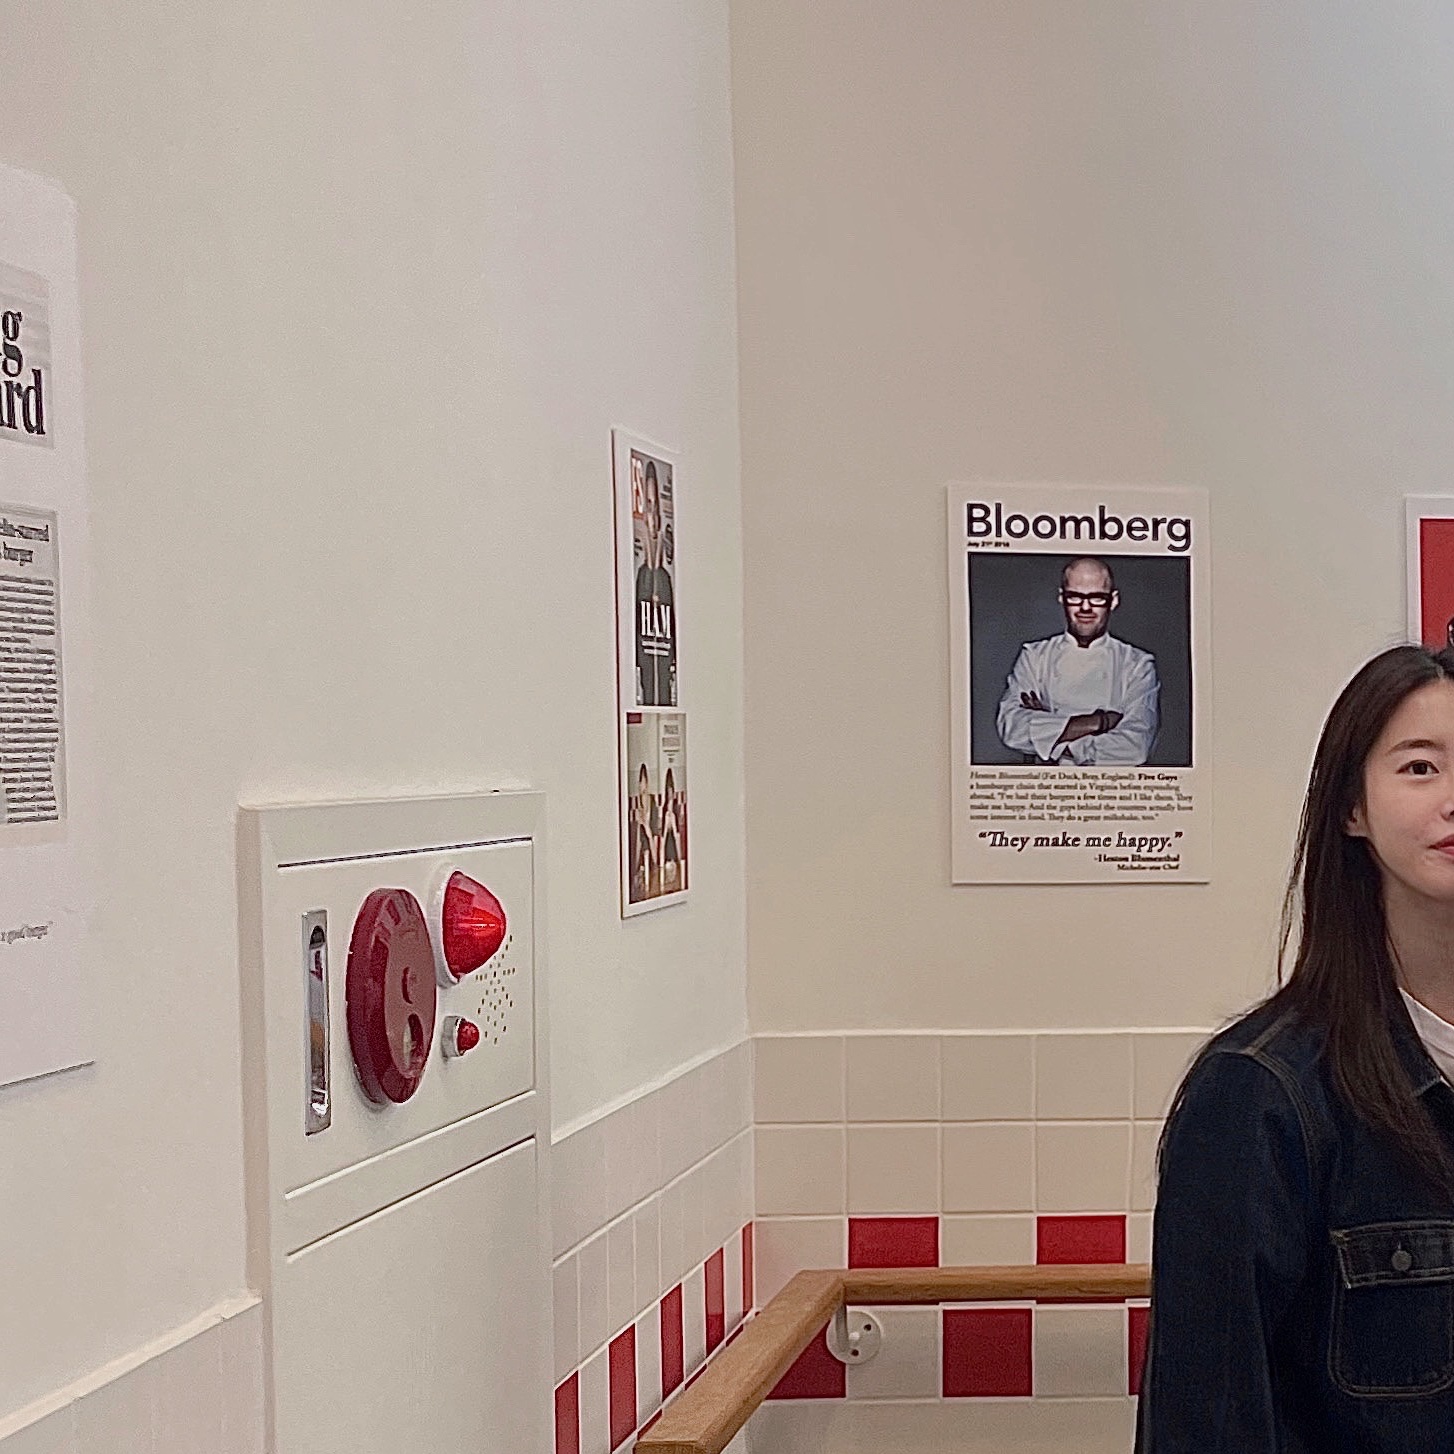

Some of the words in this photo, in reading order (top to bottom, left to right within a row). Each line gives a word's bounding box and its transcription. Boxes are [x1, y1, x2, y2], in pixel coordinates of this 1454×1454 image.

[0, 310, 23, 377] g
[967, 502, 1191, 552] Bloomberg
[1138, 773, 1155, 781] Five
[1157, 773, 1178, 783] Guys
[978, 831, 1030, 853] “They
[1033, 831, 1081, 848] make
[1085, 836, 1112, 848] me
[1116, 831, 1183, 853] happy.”
